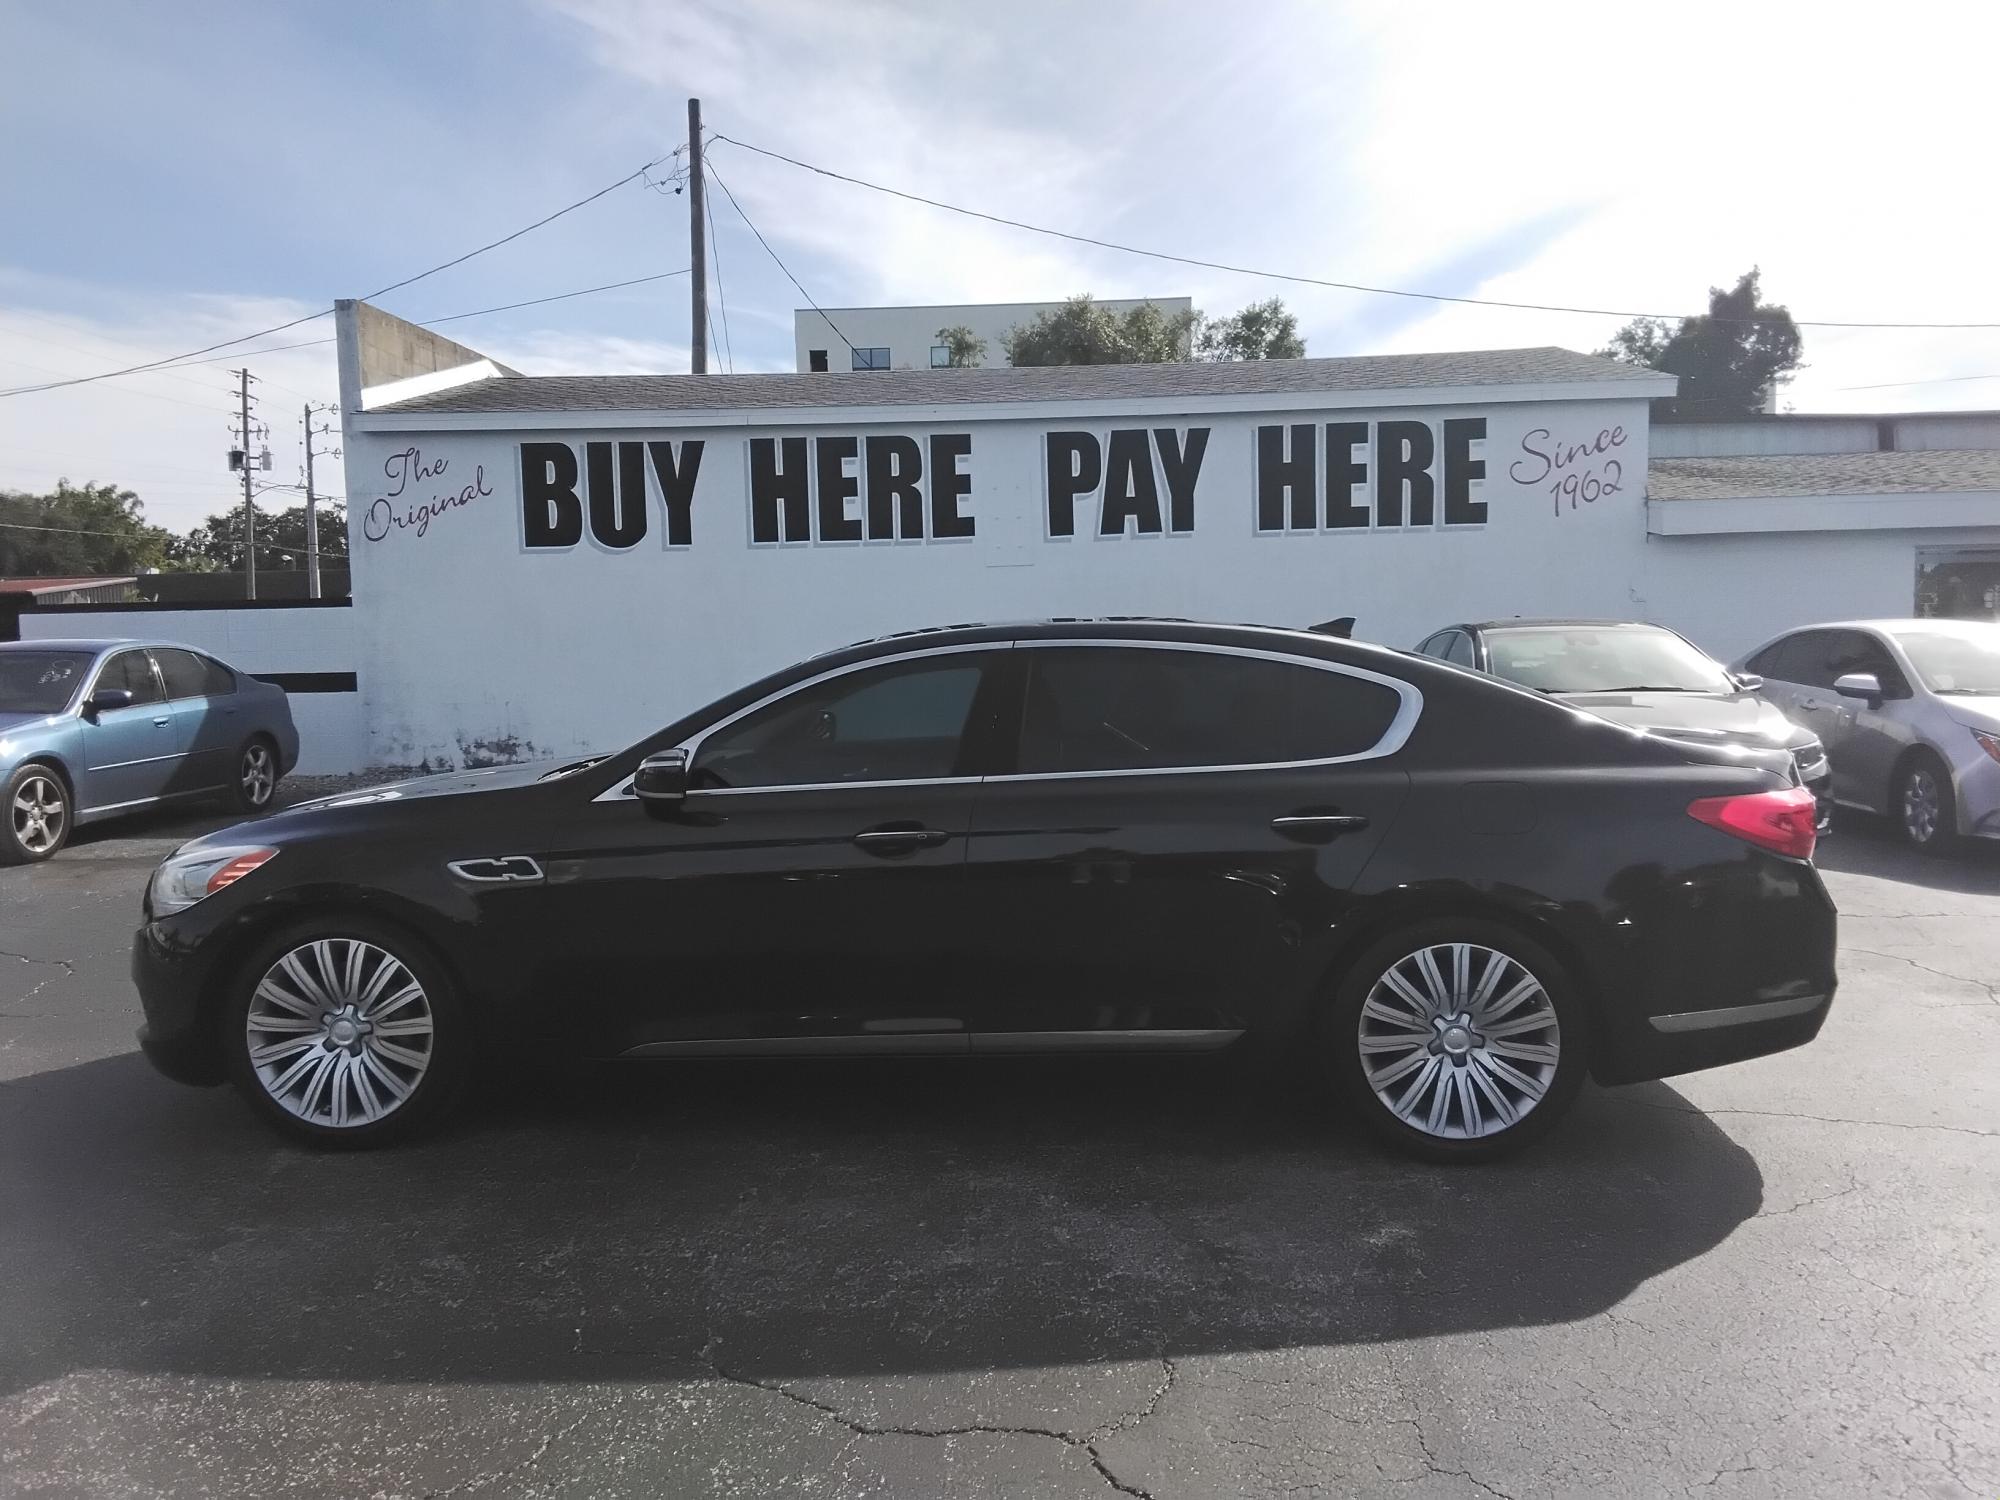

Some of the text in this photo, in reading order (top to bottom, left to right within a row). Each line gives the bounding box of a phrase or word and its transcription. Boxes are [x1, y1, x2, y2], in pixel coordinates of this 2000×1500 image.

[385, 447, 449, 497] The
[519, 417, 1488, 549] BUY HERE PAY HERE
[1509, 426, 1628, 486] Since
[363, 464, 494, 542] Original
[1549, 459, 1624, 518] 1962
